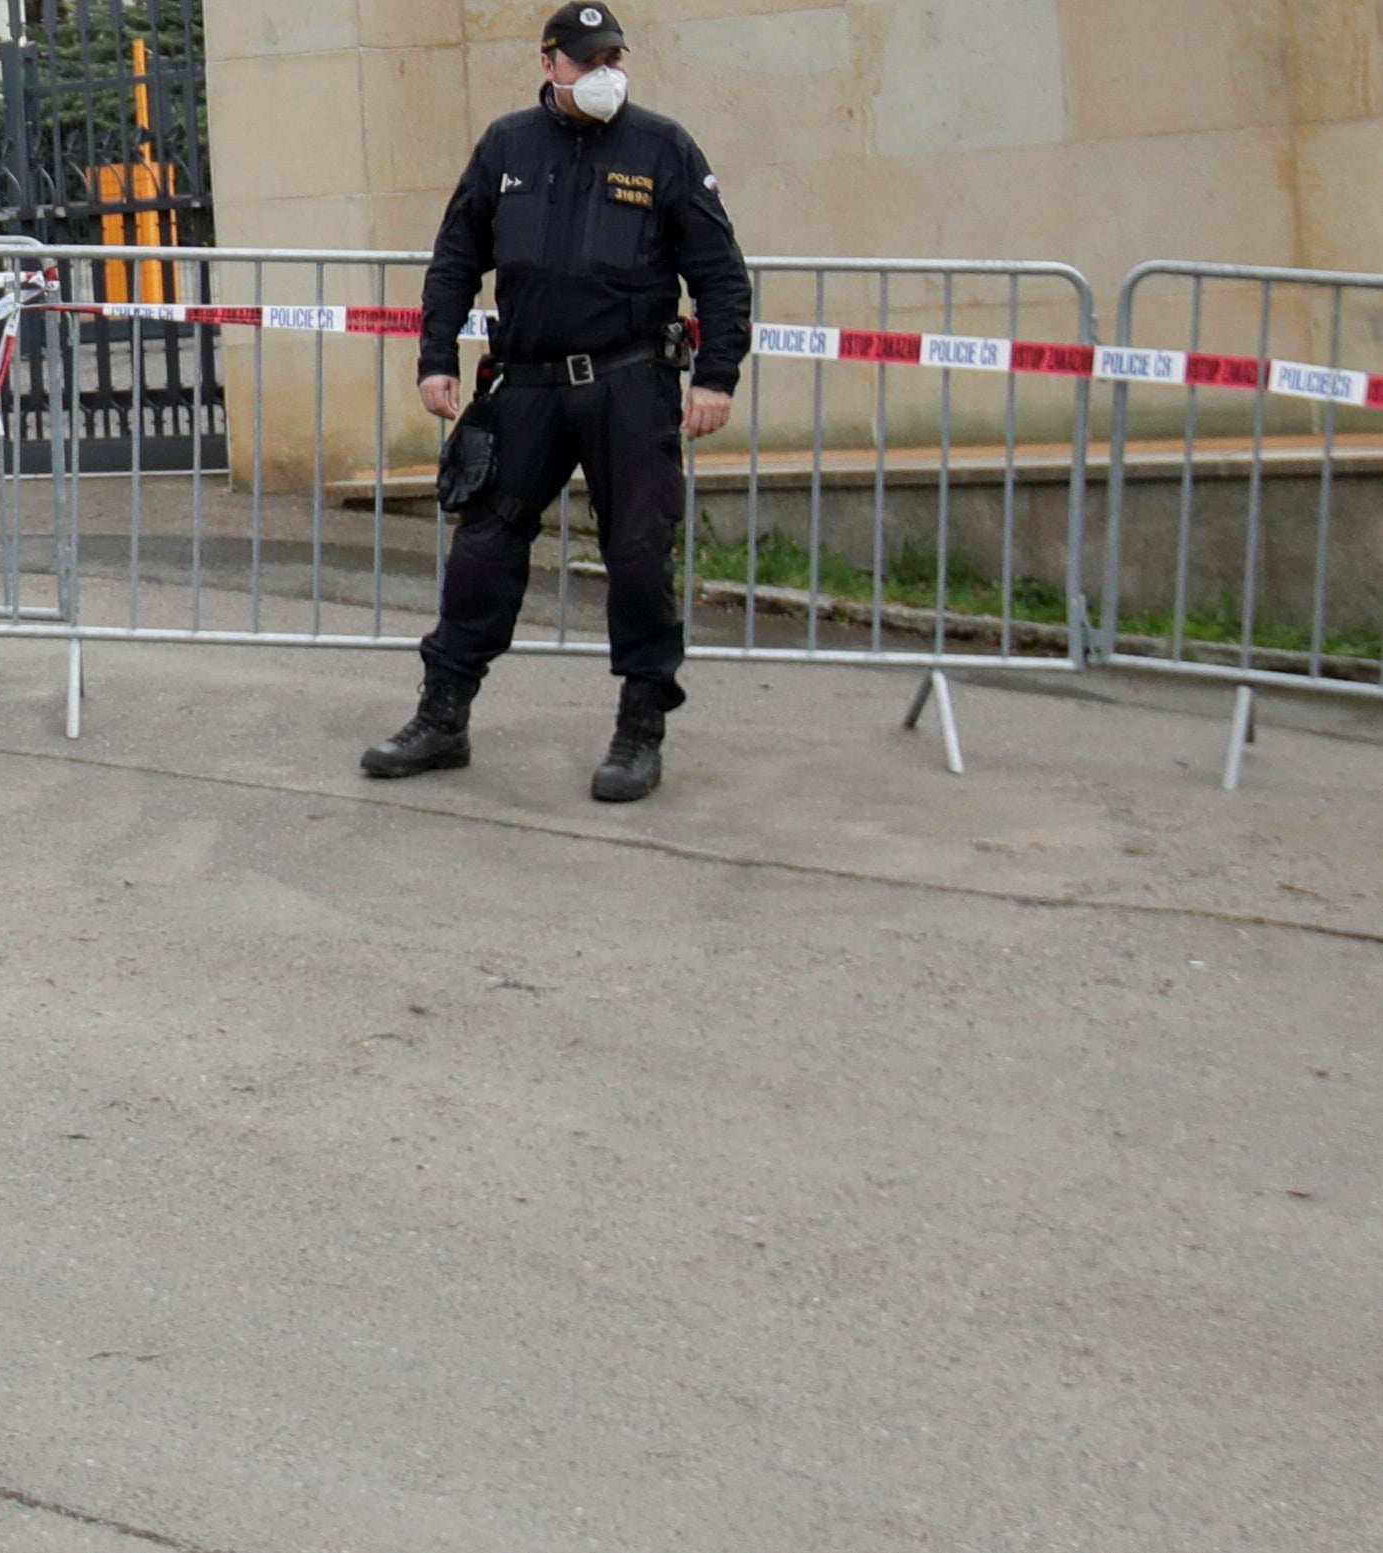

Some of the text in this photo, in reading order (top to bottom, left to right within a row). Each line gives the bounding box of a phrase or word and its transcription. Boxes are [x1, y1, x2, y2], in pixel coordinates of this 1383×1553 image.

[607, 171, 654, 190] POLICIE
[270, 308, 314, 328] POLICIE
[759, 328, 805, 352] POLICIE
[928, 339, 975, 365] POLICIE
[1101, 350, 1149, 377] POLICIE
[1278, 366, 1327, 396] POLICIE
